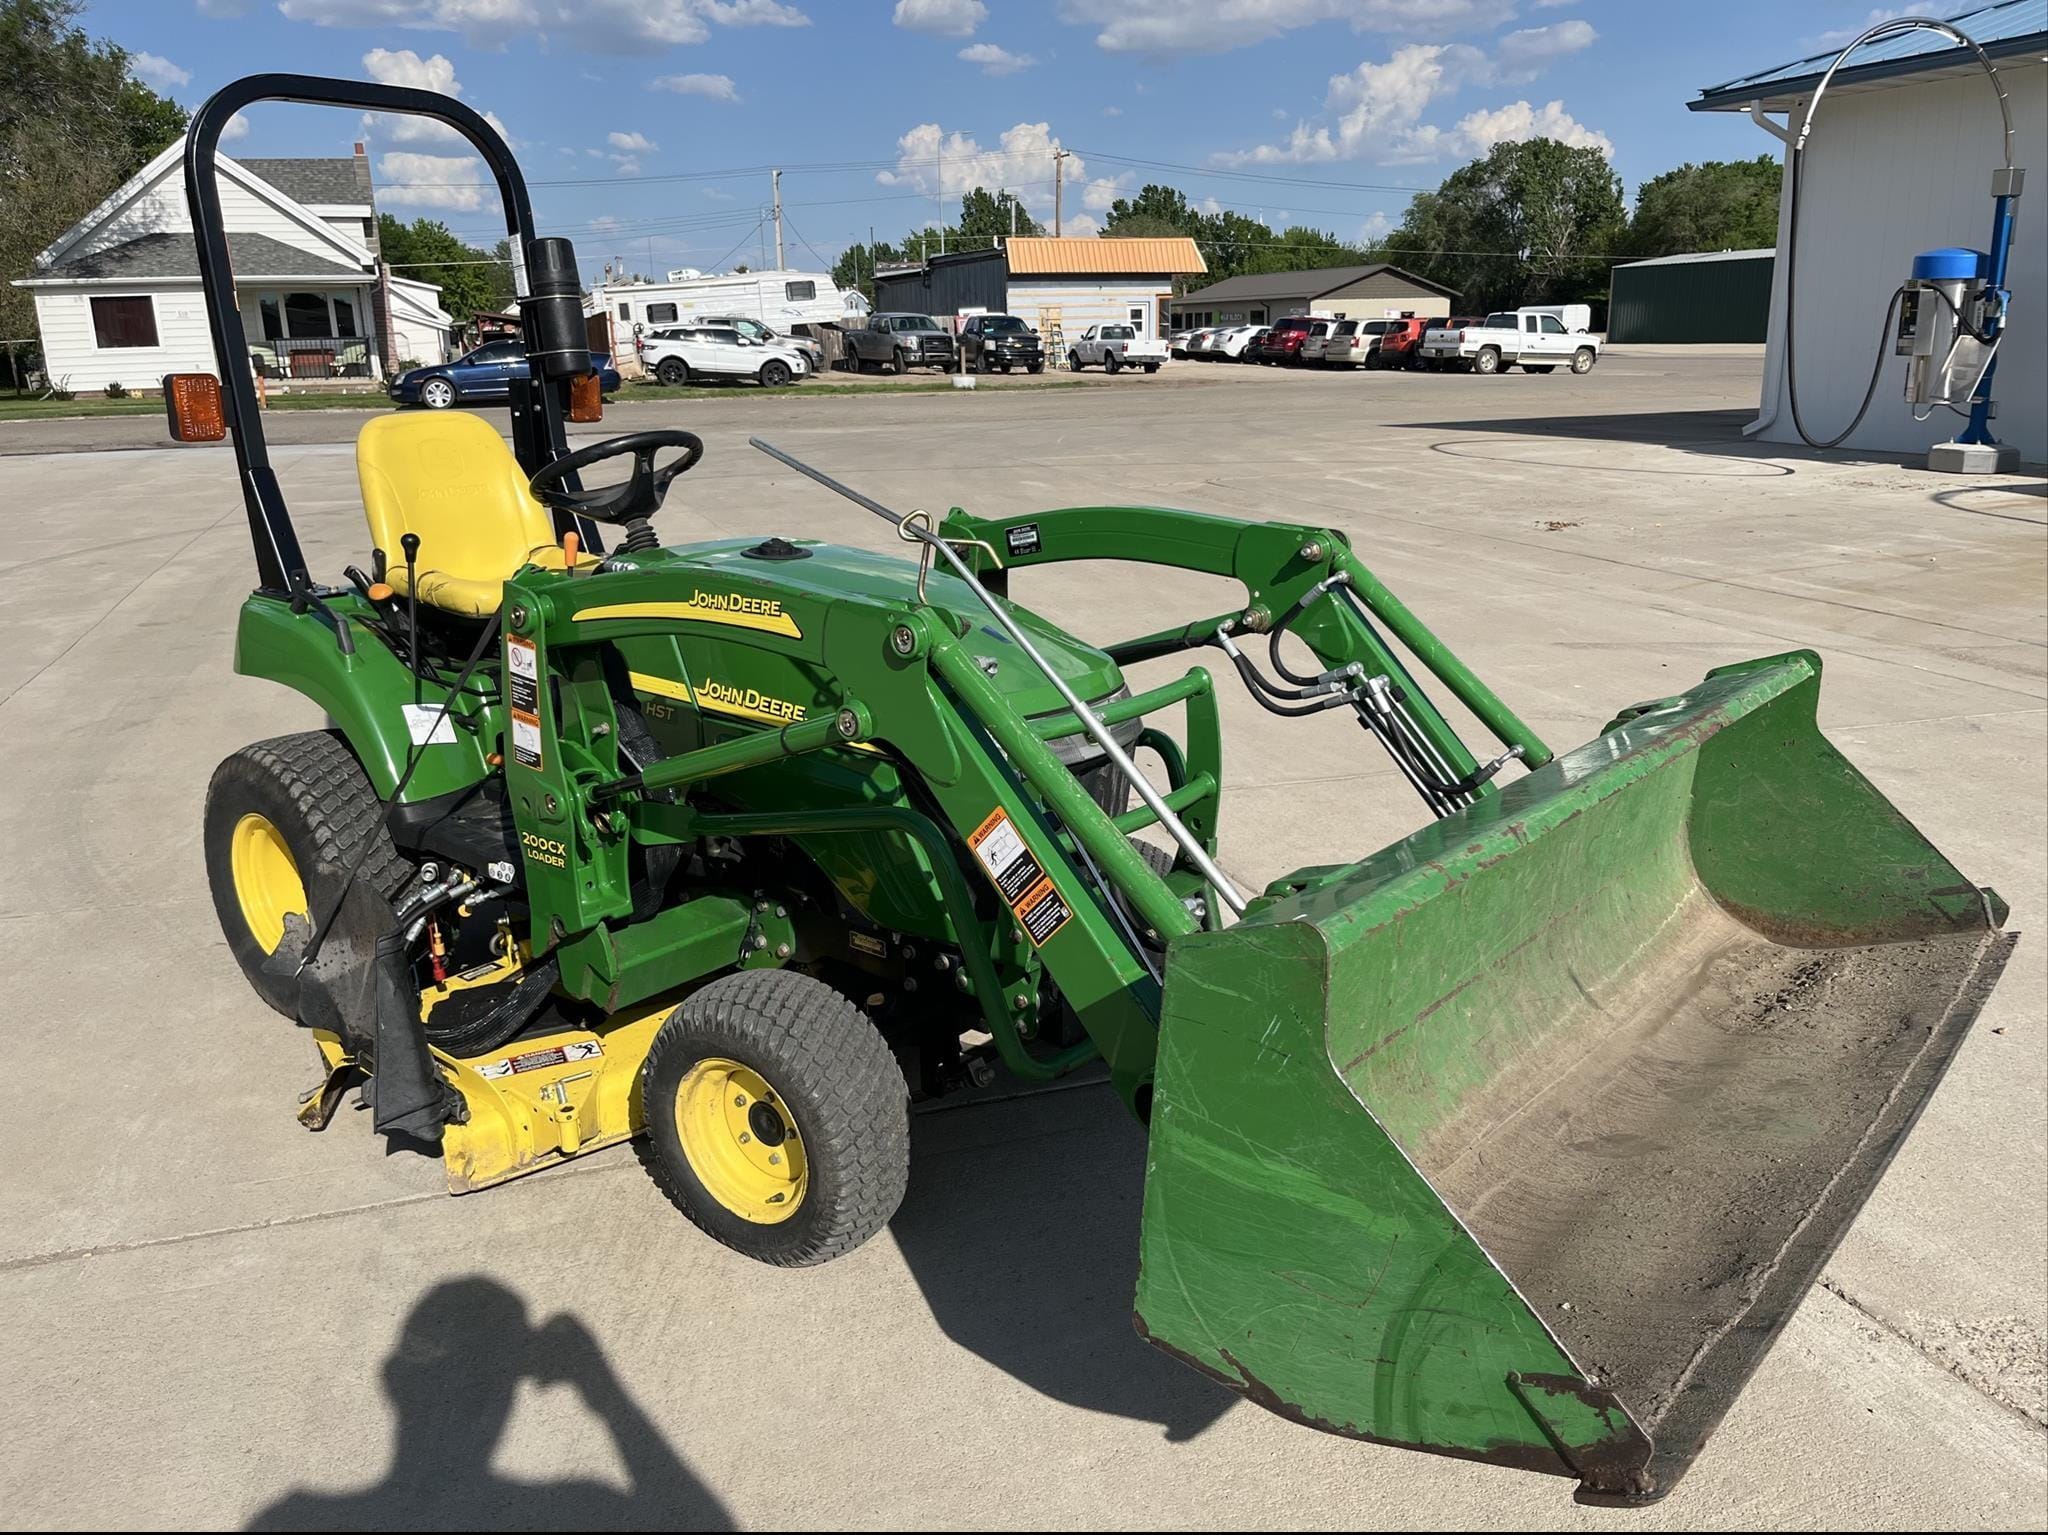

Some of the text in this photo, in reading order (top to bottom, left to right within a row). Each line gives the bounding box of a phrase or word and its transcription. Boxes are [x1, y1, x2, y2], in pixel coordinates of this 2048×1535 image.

[689, 589, 781, 616] JOHN DEERE
[700, 677, 743, 706] JOHN
[646, 702, 675, 721] HST
[978, 813, 1002, 838] WARNING
[522, 831, 567, 857] 200CX
[527, 848, 566, 869] LOADER
[1025, 884, 1050, 909] WARNING
